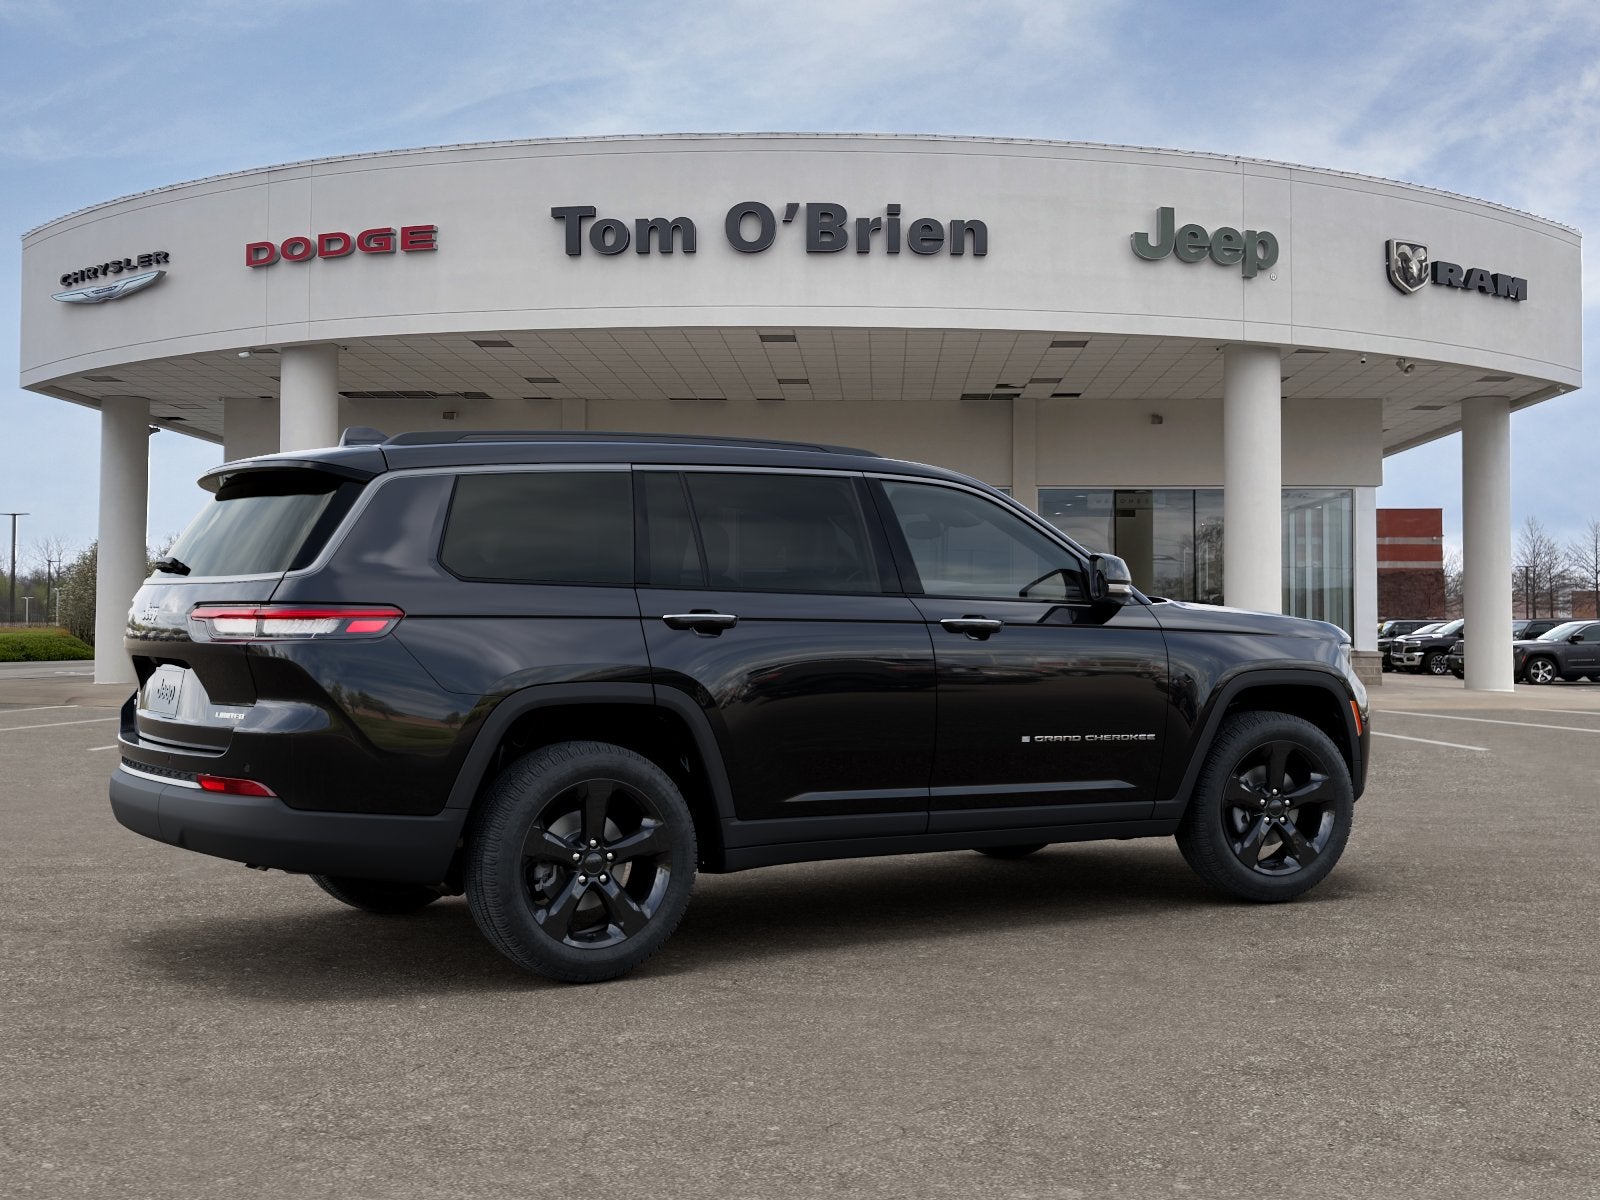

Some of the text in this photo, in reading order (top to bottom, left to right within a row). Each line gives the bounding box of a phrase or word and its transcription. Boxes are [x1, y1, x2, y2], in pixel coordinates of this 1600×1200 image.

[245, 224, 439, 270] DODGE
[551, 200, 989, 257] Tom O'Brien
[1129, 206, 1280, 279] Jeep
[60, 250, 170, 287] CHRYSLER
[1430, 260, 1529, 301] RAM
[214, 711, 246, 720] LIMITED
[1084, 733, 1156, 742] CHEROKEE
